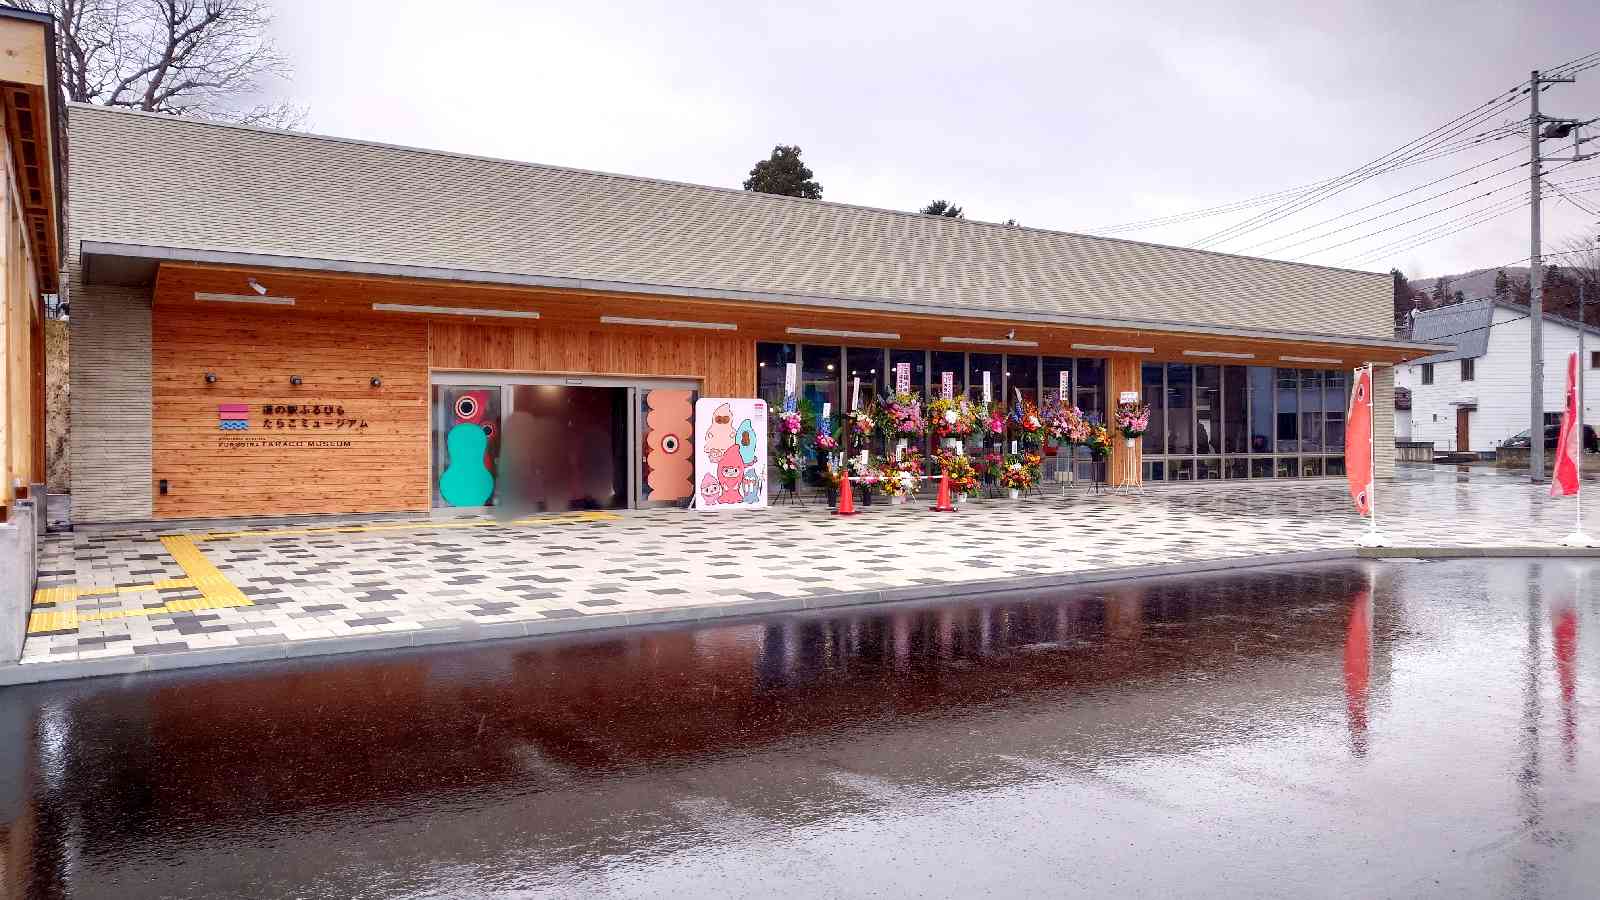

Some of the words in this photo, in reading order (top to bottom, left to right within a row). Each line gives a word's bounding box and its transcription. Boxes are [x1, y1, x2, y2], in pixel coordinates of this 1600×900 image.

[263, 418, 368, 428] たらこミュージアム
